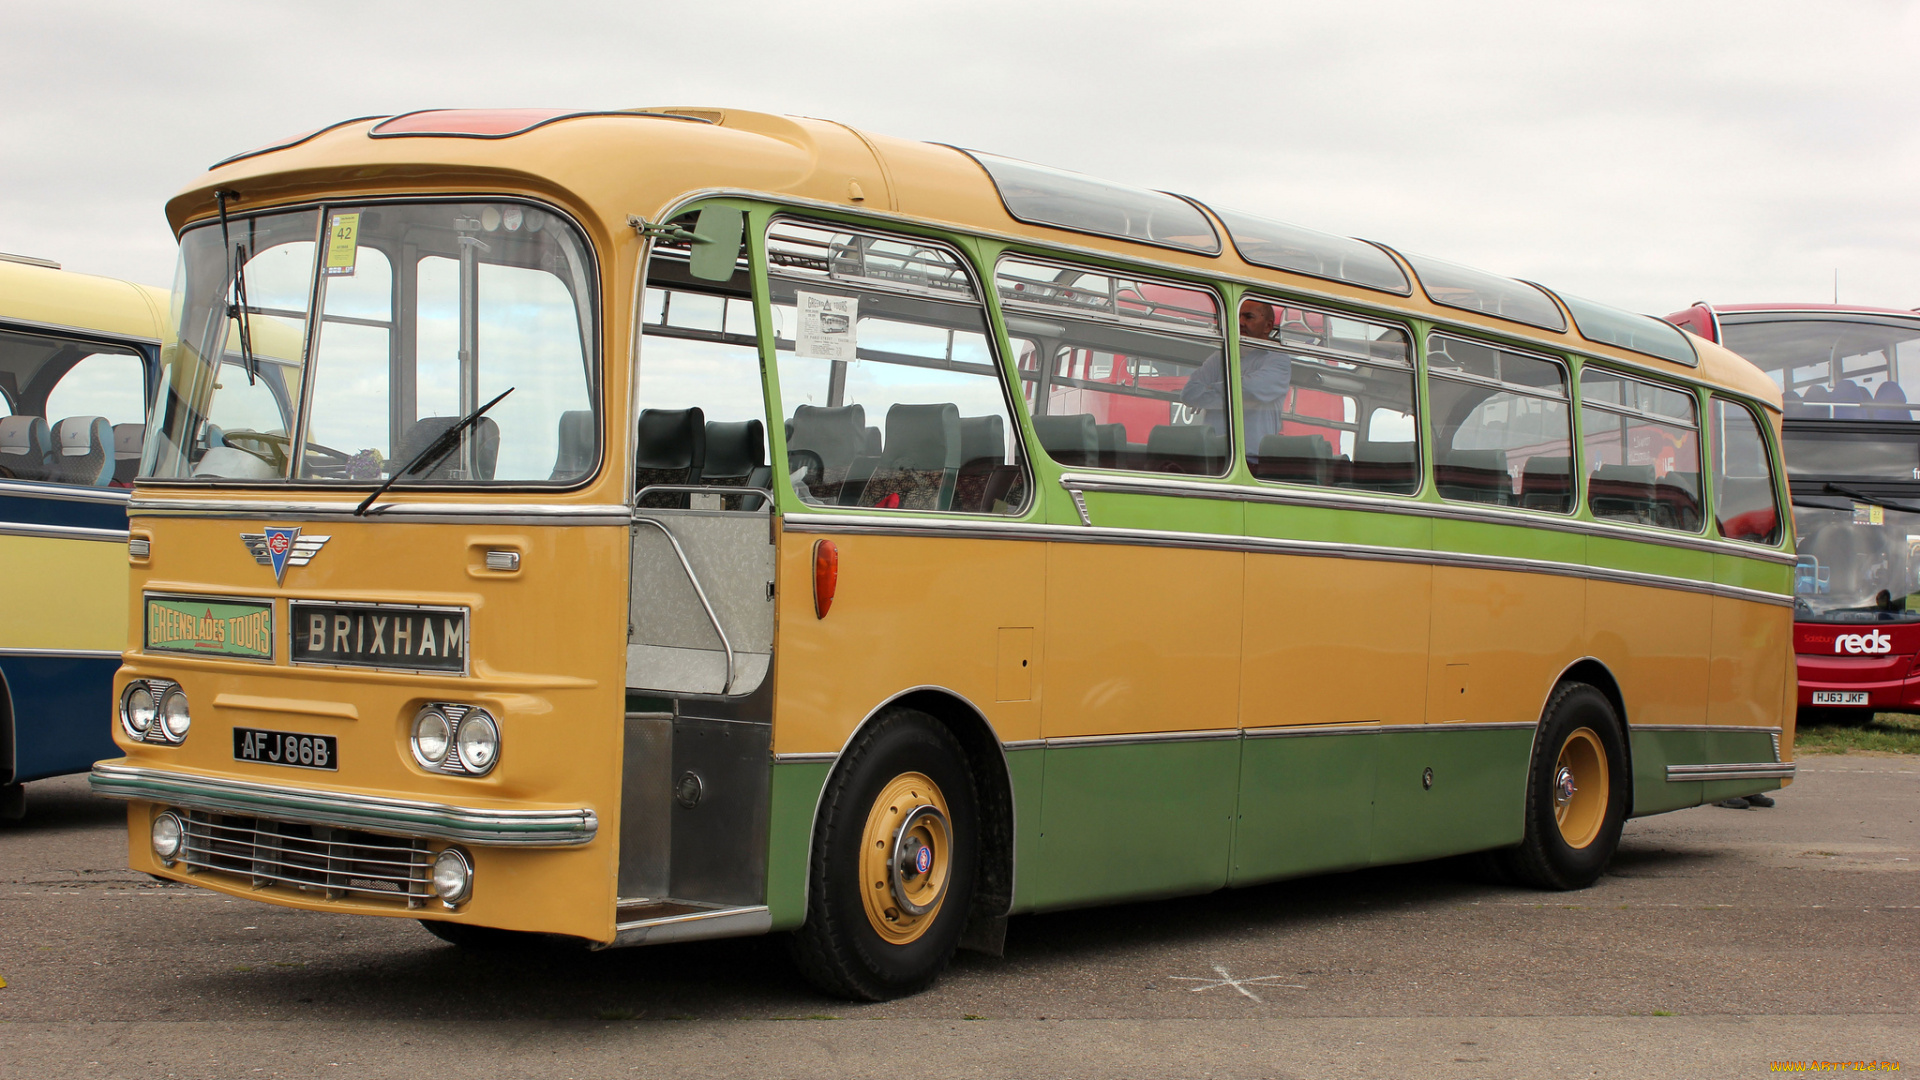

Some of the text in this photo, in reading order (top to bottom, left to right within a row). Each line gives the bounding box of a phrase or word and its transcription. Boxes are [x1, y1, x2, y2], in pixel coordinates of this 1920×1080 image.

[337, 227, 352, 240] 42
[271, 538, 288, 547] AEC
[150, 603, 270, 655] GREENSLADES TOURS
[308, 614, 463, 658] BRIXHAM
[1804, 629, 1891, 653] Salisbury reds
[1817, 692, 1864, 703] HJ63 JKF
